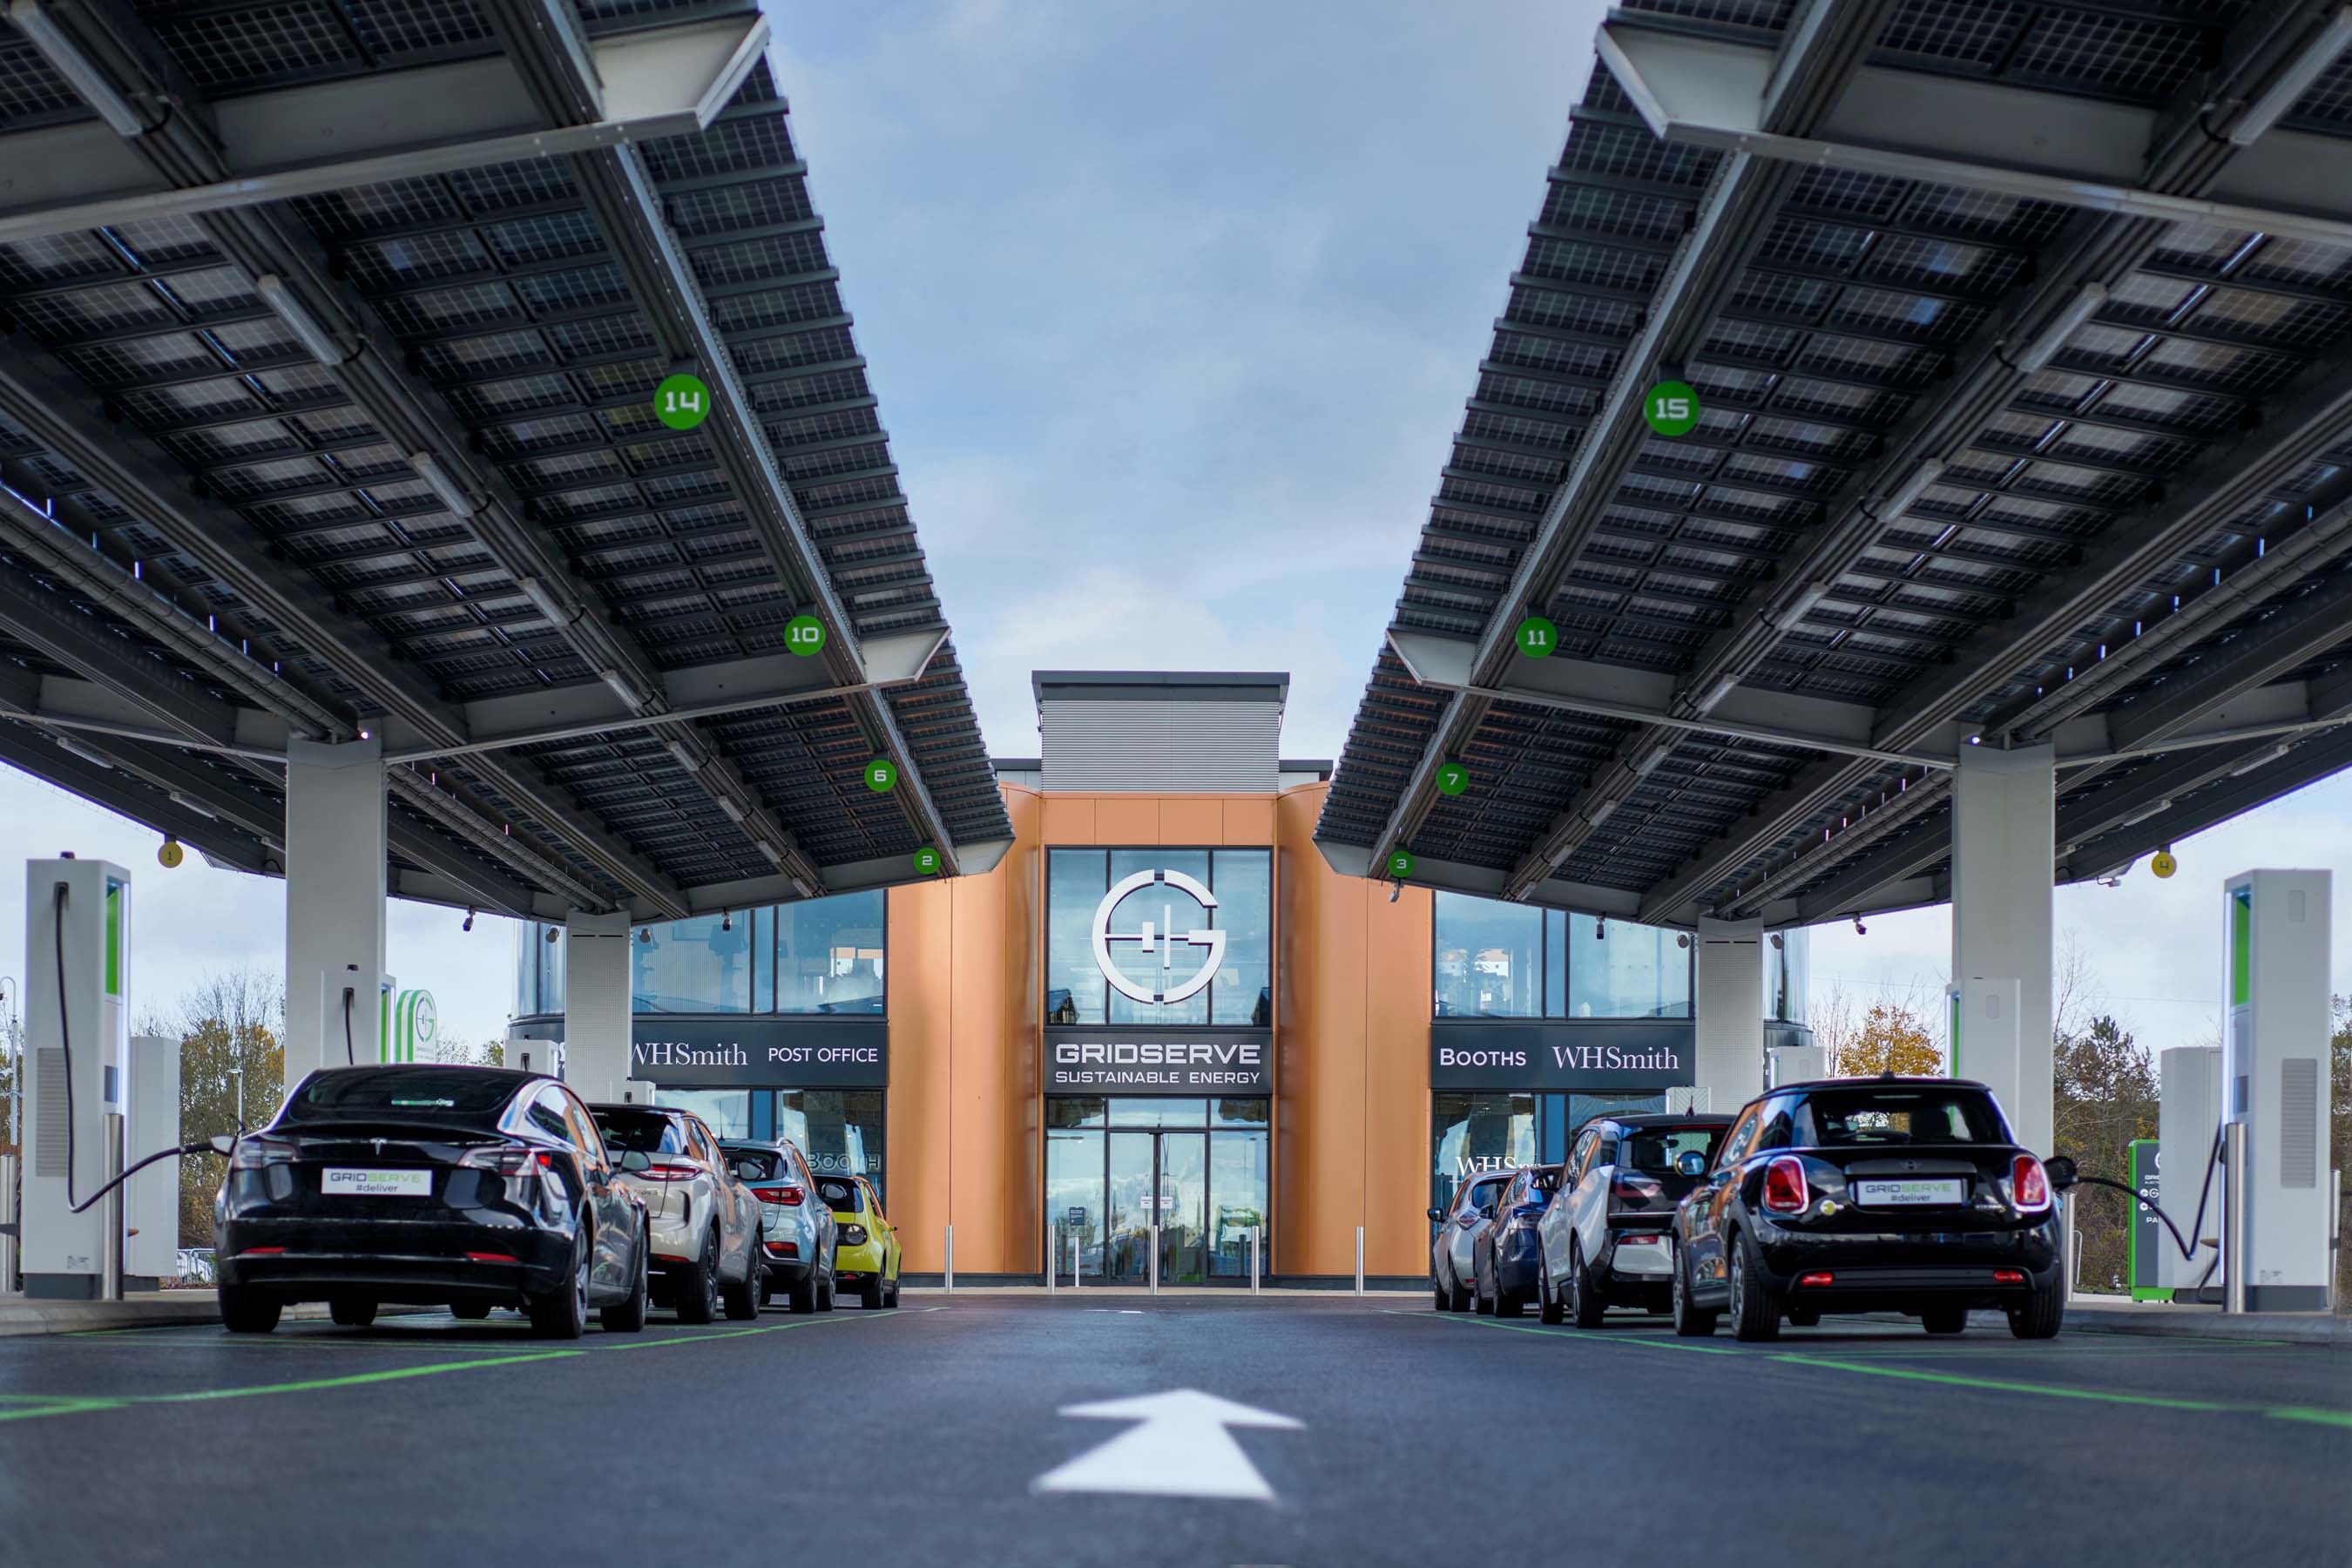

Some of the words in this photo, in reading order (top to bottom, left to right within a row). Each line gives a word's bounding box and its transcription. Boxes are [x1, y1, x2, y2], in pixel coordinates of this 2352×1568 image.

[665, 391, 700, 413] 14
[1655, 397, 1689, 419] 15
[792, 626, 819, 642] 10
[1527, 630, 1547, 645] 11
[874, 769, 887, 781] 6
[1447, 773, 1458, 785] 7
[166, 850, 173, 861] 1
[922, 855, 933, 866] 2
[1396, 858, 1407, 868] 3
[2159, 861, 2169, 870] 4
[631, 1042, 748, 1065] WHSmith
[768, 1047, 812, 1062] POST
[817, 1047, 878, 1063] OFFICE
[1056, 1044, 1261, 1064] GRIDSERVE
[1551, 1045, 1680, 1069] WHSmith
[1055, 1071, 1180, 1084] SUSTAINABLE
[1189, 1071, 1261, 1084] ENERGY
[330, 1172, 421, 1183] GRIDSERVE
[355, 1184, 398, 1193] #deliver
[1865, 1183, 1952, 1193] GRIDSERVE
[1890, 1193, 1931, 1202] #deliver
